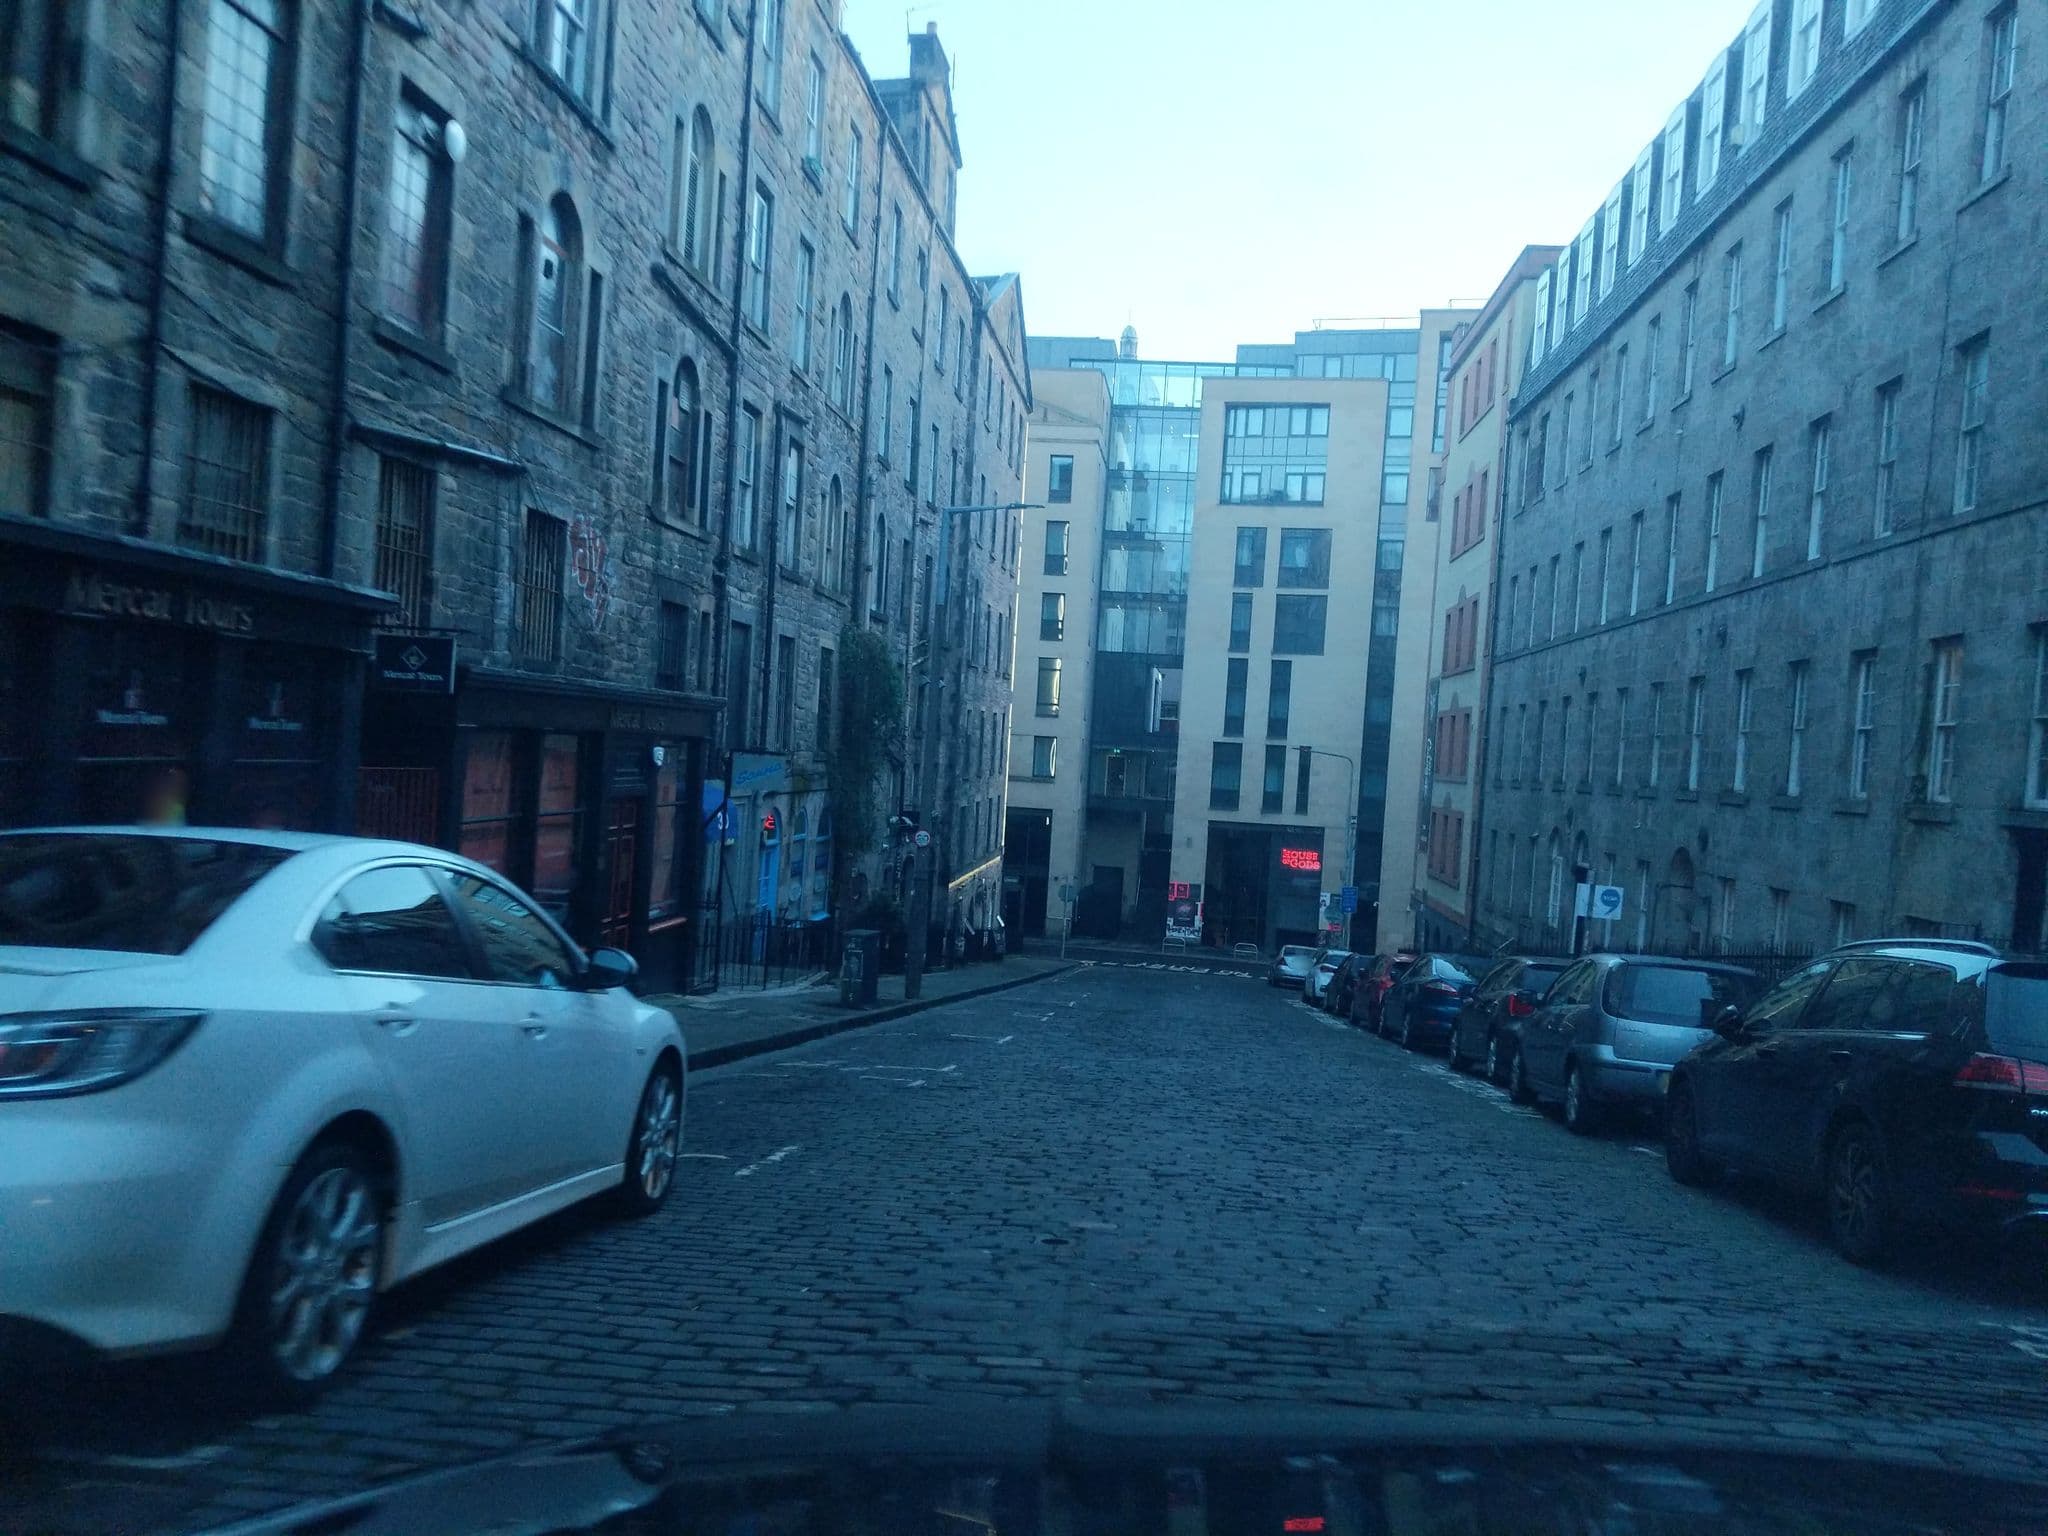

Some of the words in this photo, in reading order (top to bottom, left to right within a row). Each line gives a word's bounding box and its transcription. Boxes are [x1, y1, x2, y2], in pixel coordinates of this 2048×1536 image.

[184, 591, 254, 631] Tours
[1282, 847, 1318, 861] HOUSE
[1290, 858, 1321, 871] GODS
